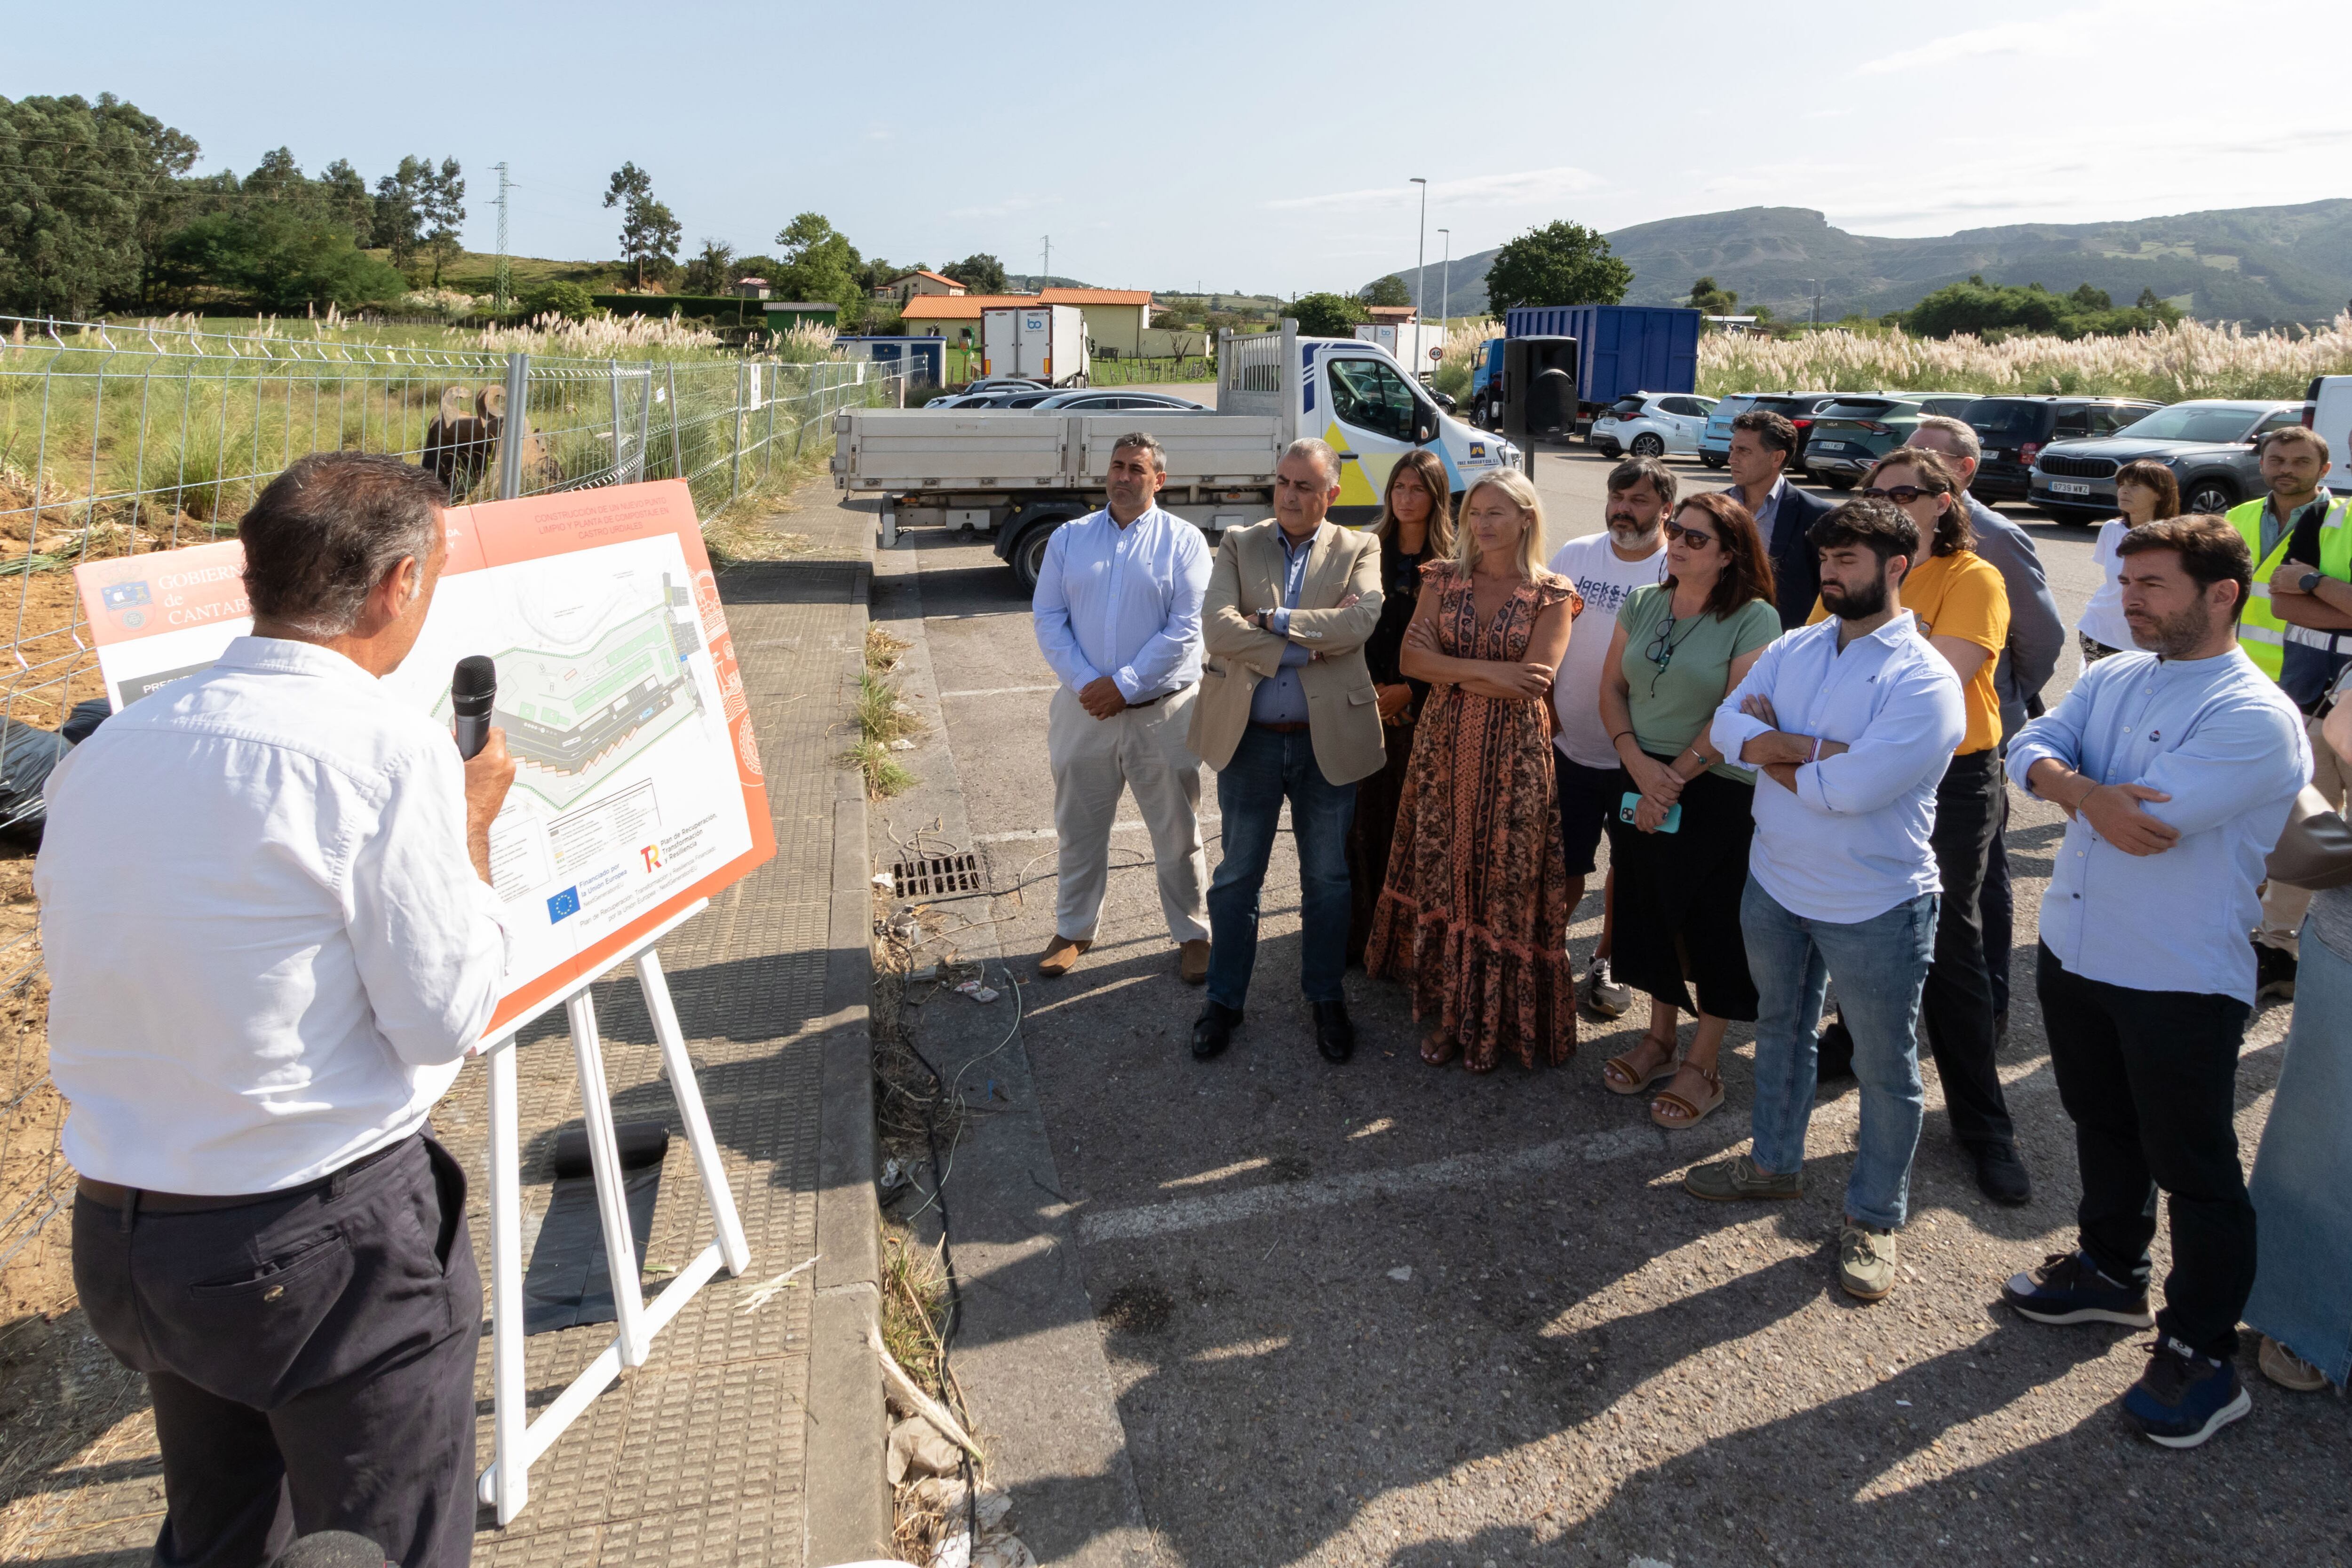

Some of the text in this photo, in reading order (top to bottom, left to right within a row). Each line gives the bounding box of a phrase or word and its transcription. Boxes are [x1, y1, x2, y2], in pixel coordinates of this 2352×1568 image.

[2053, 483, 2071, 491] 8739
[535, 507, 597, 523] CONSTRUCCIÓN
[598, 506, 609, 514] DE
[620, 500, 644, 510] NUEVO
[645, 497, 667, 506] PUNTO
[539, 523, 565, 535] LIMPIO
[574, 518, 603, 529] PLANTA
[615, 508, 660, 522] COMPOSTAJE
[660, 507, 669, 515] EN
[579, 522, 644, 539] CASTRO URDIALES
[159, 564, 243, 589] GOBIERN
[1574, 576, 1632, 598] Jack&J
[165, 594, 183, 608] de
[168, 597, 250, 625] CANTAB
[660, 837, 673, 847] Plan
[669, 841, 697, 860] Resiliencia
[580, 863, 620, 888] Financiado por
[605, 870, 627, 884] Europea
